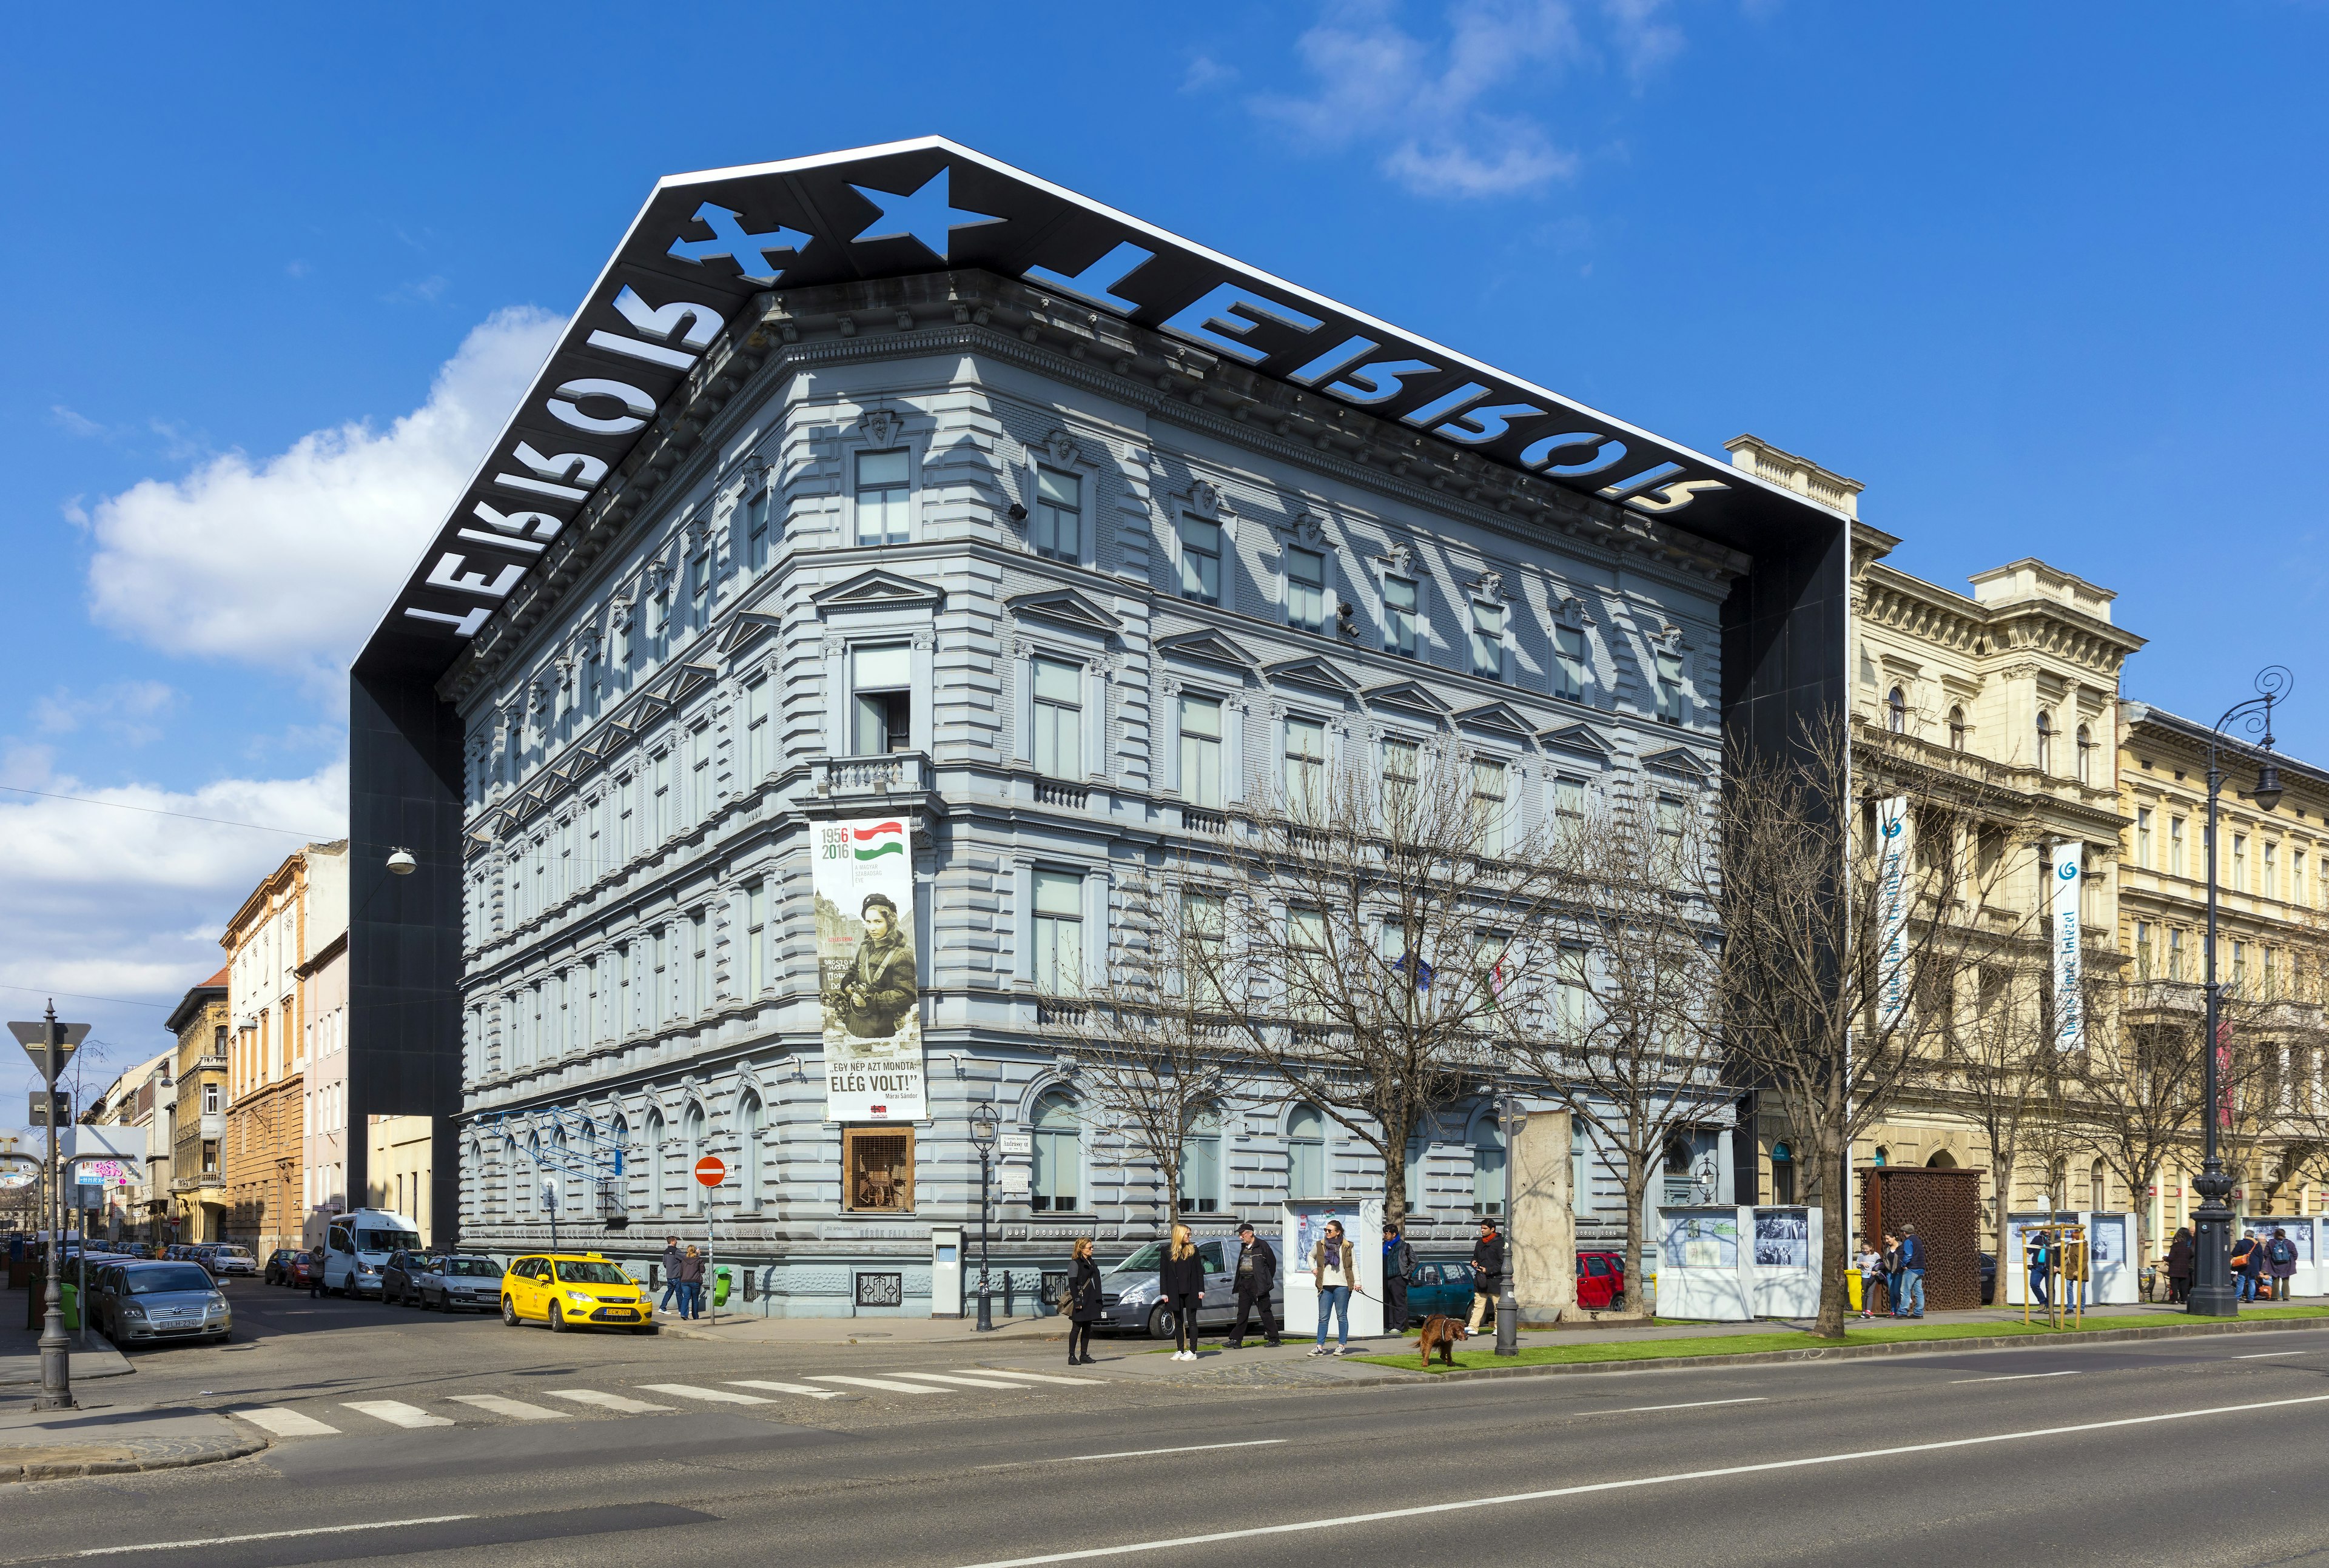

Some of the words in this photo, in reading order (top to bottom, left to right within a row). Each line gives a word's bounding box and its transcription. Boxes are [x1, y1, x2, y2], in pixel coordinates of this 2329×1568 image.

[821, 828, 849, 843] 1956
[822, 843, 849, 859] 2016
[851, 1061, 865, 1071] NÉP
[868, 1062, 881, 1071] AZT
[884, 1062, 916, 1071] MONDTA:
[831, 1073, 865, 1092] ELÉG
[860, 1227, 885, 1238] HŐSÖK
[889, 1229, 907, 1238] FALA
